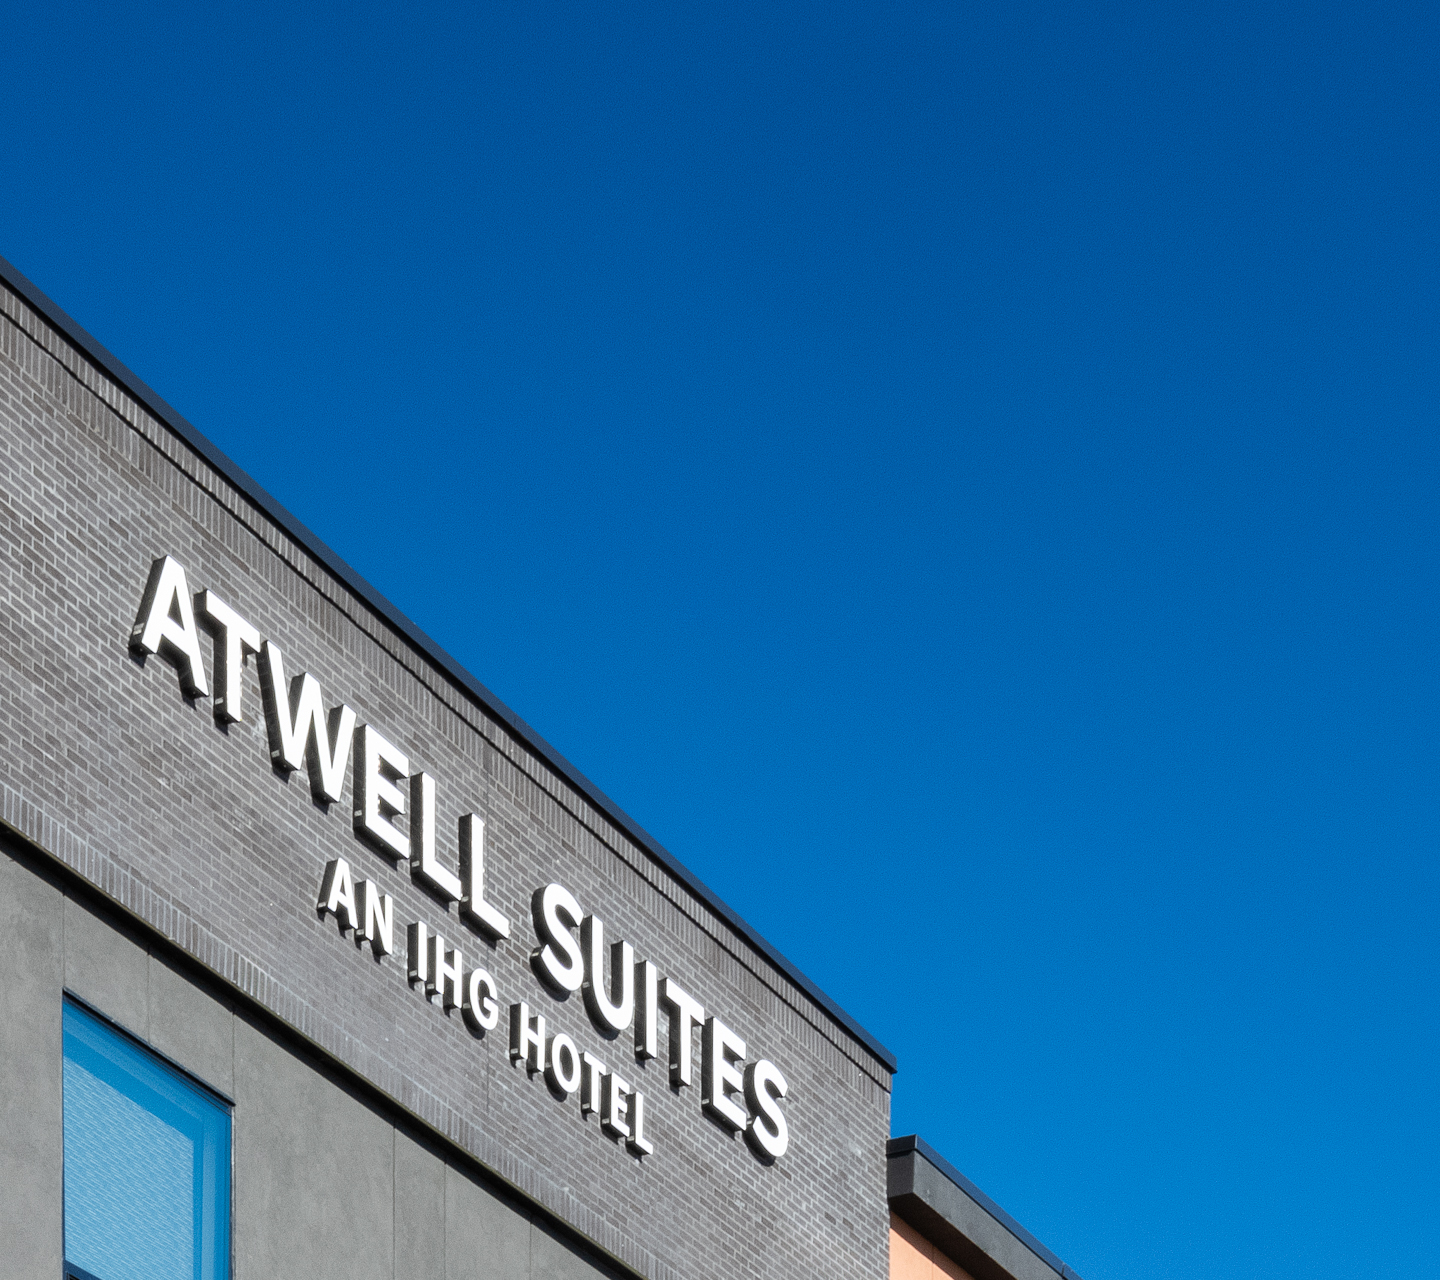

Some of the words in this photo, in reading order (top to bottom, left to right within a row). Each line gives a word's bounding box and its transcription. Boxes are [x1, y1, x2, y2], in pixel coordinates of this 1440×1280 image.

[130, 554, 510, 940] ATWELL
[531, 882, 789, 1158] SUITES
[318, 857, 394, 956] AN
[407, 920, 500, 1038] IHG
[510, 1000, 654, 1157] HOTEL
